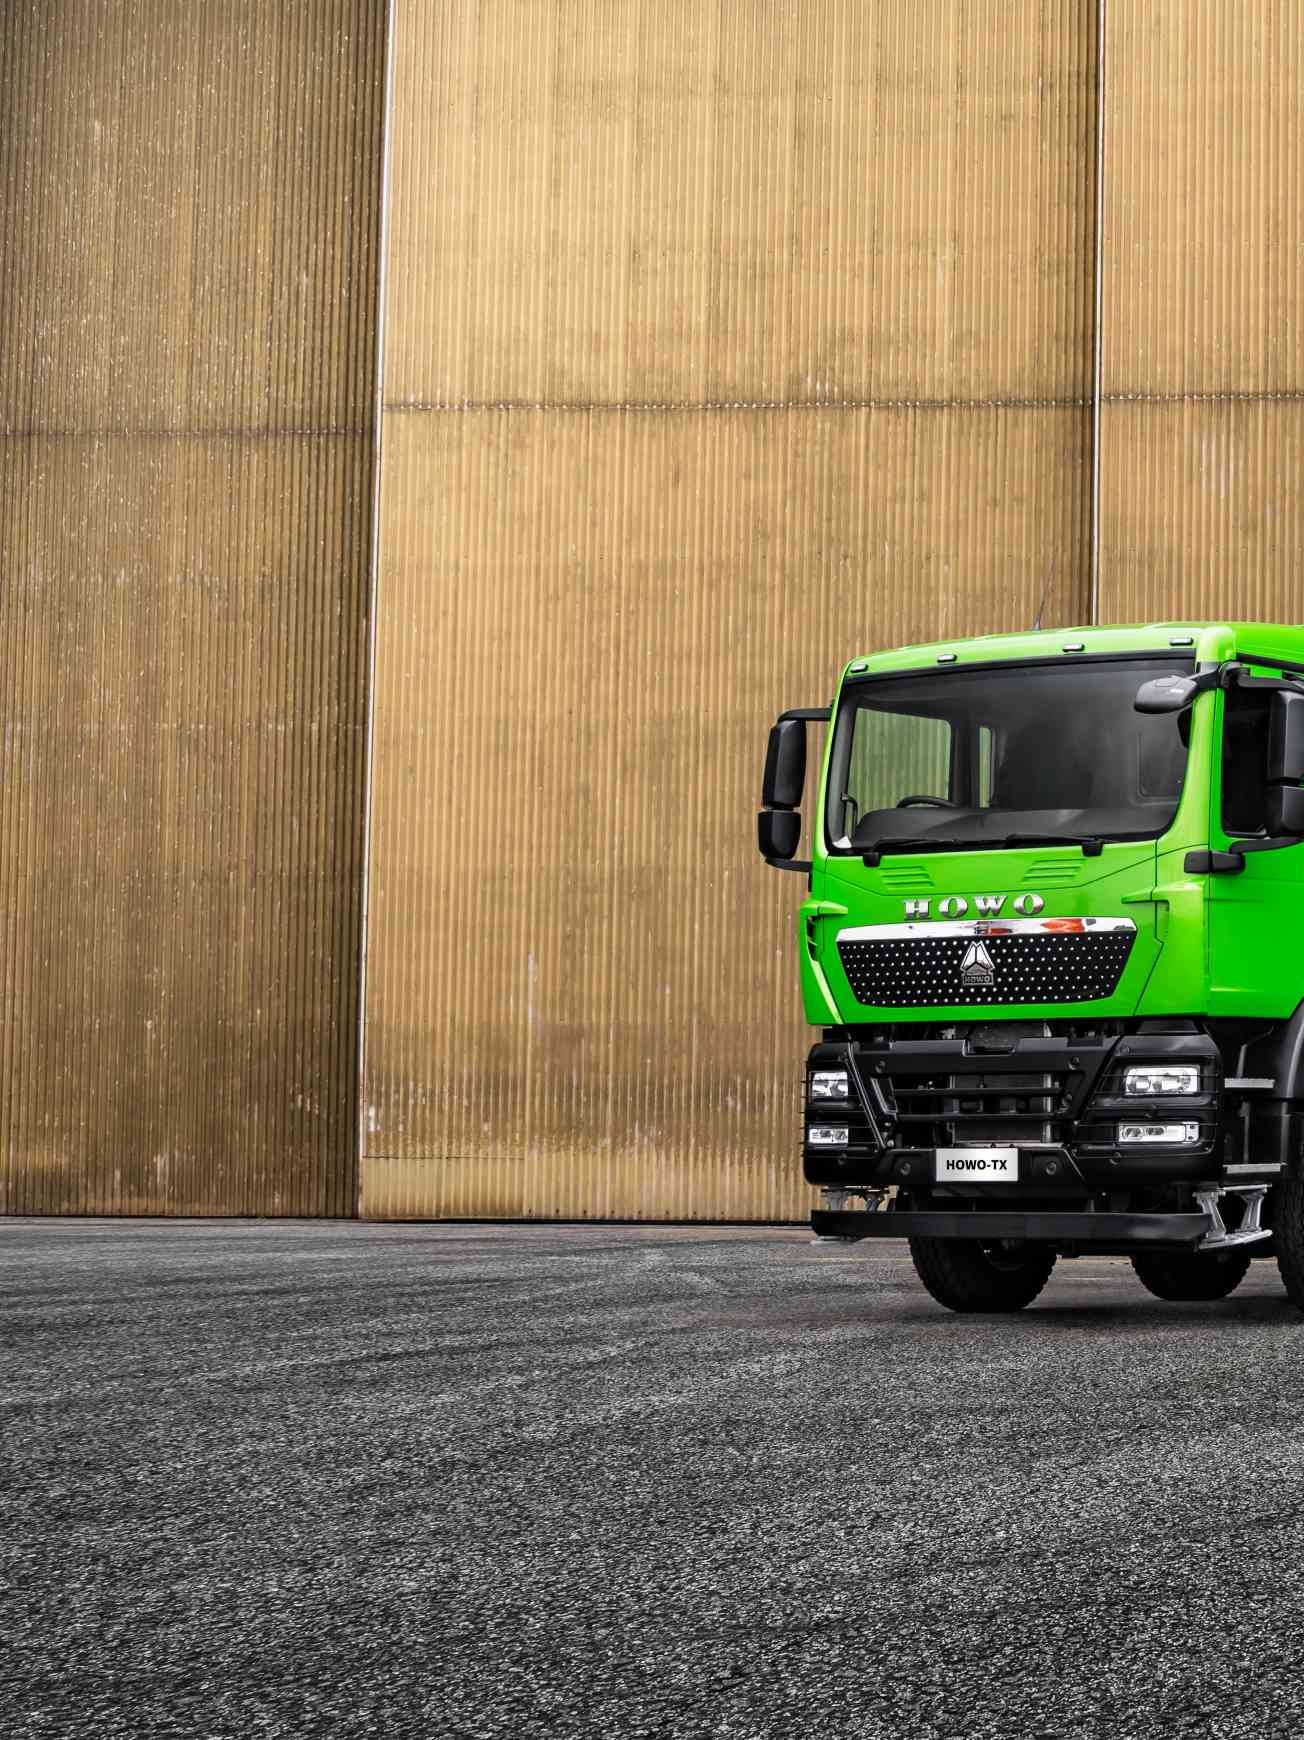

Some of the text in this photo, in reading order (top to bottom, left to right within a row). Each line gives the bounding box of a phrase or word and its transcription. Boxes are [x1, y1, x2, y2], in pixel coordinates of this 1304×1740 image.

[903, 893, 1045, 920] HOWO
[964, 975, 991, 983] HOWO
[946, 1159, 1008, 1171] HOWO-TX
